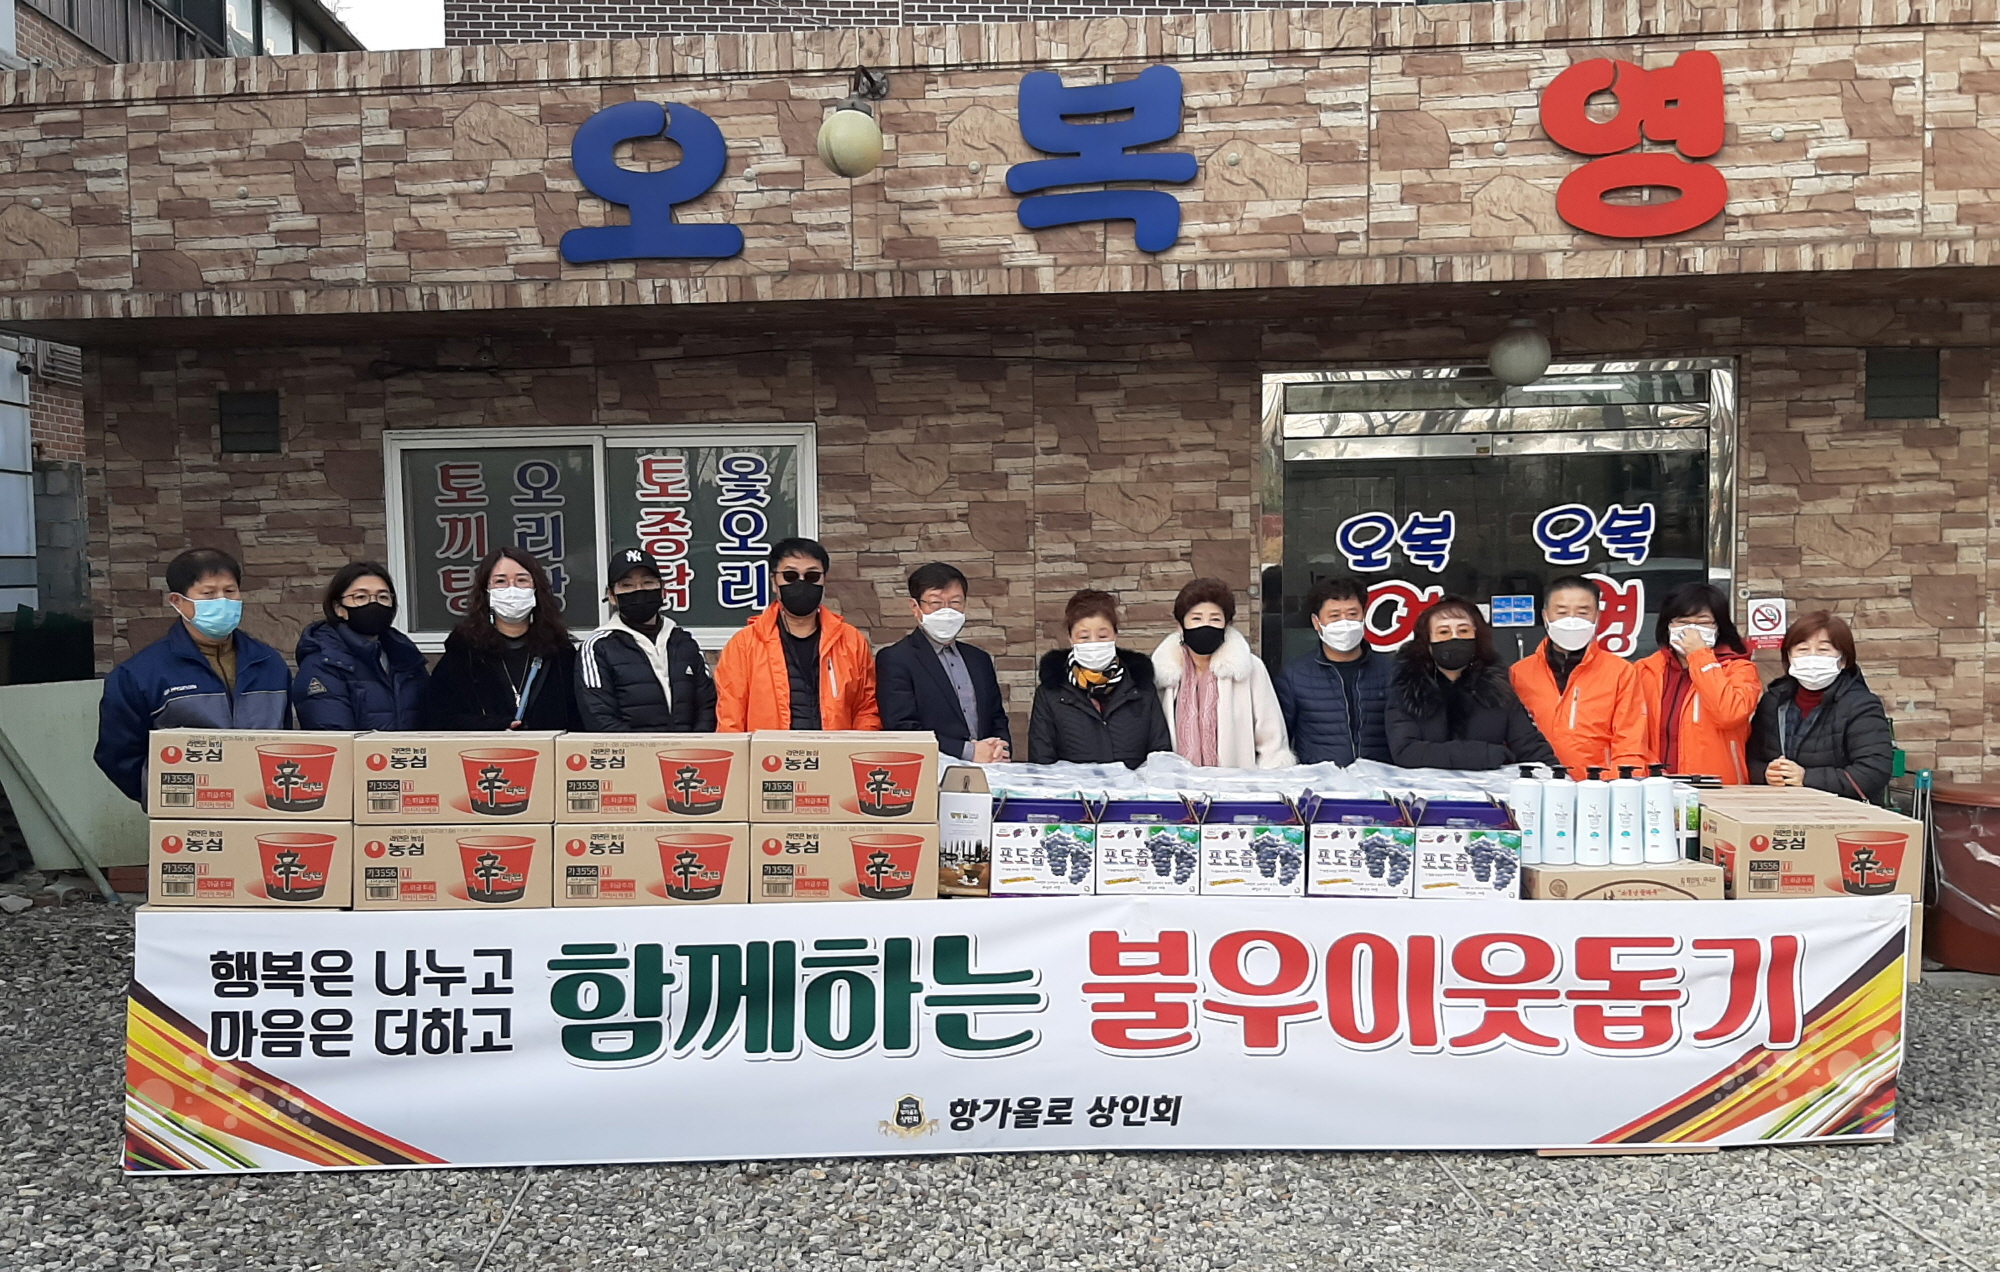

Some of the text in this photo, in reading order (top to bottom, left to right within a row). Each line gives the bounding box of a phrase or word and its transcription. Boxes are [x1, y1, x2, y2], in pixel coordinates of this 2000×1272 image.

[716, 452, 772, 610] 옻오리
[1533, 503, 1655, 565] 오복
[1336, 510, 1455, 573] 오복
[185, 748, 223, 762] 농심
[390, 755, 427, 769] 농심
[590, 756, 626, 769] 농심
[784, 757, 820, 770] 농심
[163, 774, 193, 784] 가3556
[369, 781, 399, 790] 가3556
[569, 781, 598, 790] 가3556
[763, 782, 792, 791] 가3556
[186, 838, 223, 852] 농심
[388, 843, 425, 856] 농심
[589, 841, 625, 854] 농심
[784, 841, 820, 853] 농심
[1772, 837, 1806, 850] 농심
[999, 846, 1046, 867] 포도즙
[1104, 847, 1150, 867] 포도즙
[1207, 848, 1254, 868] 포도즙
[1316, 848, 1365, 868] 포도즙
[1421, 852, 1472, 872] 포도즙
[164, 864, 194, 873] 가3556
[367, 868, 397, 877] 가3556
[568, 867, 597, 875] 가3556
[764, 865, 792, 874] 가3556
[1751, 862, 1778, 870] 가3556
[210, 948, 515, 998] 행복은 나누고
[546, 930, 1804, 1065] 함께하는 불우이웃돕기
[210, 1007, 514, 1059] 마음은 더하고
[949, 1094, 1183, 1131] 항가울로 상인회
